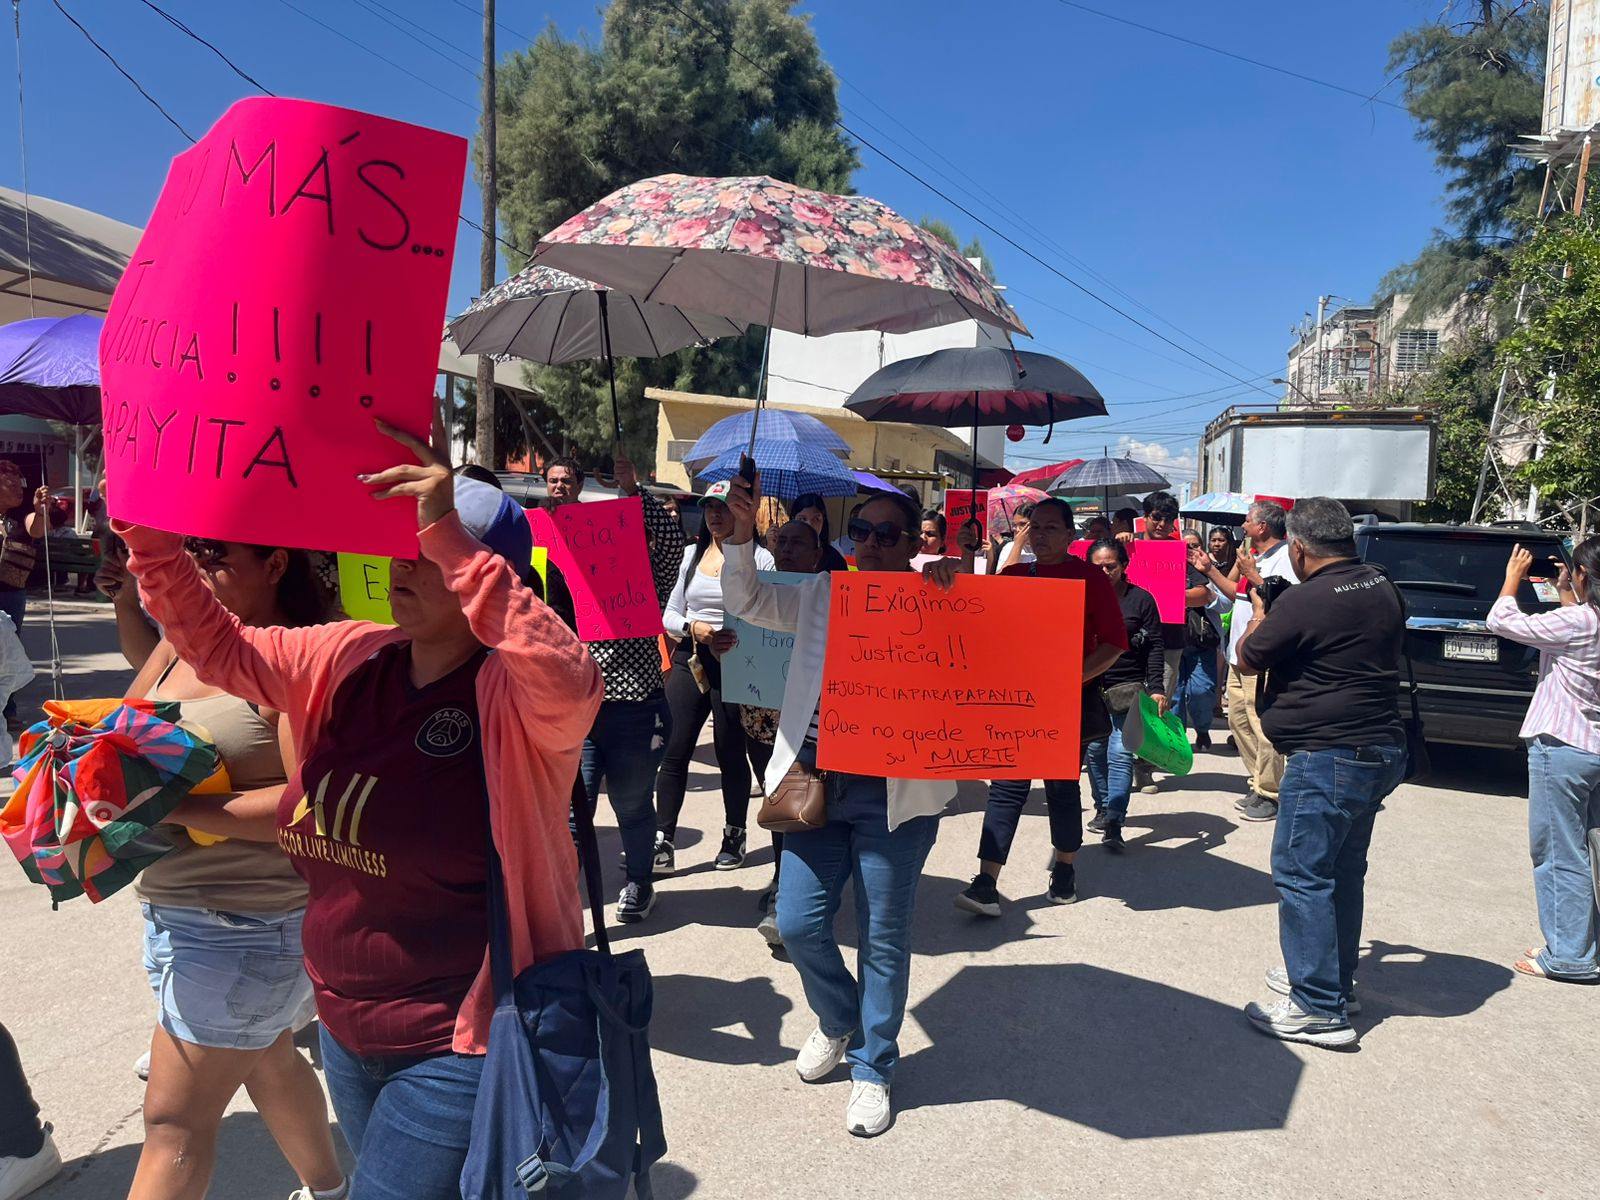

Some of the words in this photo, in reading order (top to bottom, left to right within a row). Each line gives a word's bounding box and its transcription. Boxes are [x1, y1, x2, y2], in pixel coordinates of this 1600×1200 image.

[865, 584, 985, 635] Exigimos
[848, 634, 968, 671] Justicia!!
[826, 680, 1037, 705] #JUSTICIAPARAPAPAYITA
[823, 709, 860, 734] Que
[871, 724, 895, 740] no
[903, 720, 965, 755] quede
[985, 724, 1060, 753] impune
[885, 752, 906, 766] su
[931, 748, 1016, 765] MUERTE
[305, 835, 331, 861] LIVE
[329, 841, 388, 878] LIMITLESS
